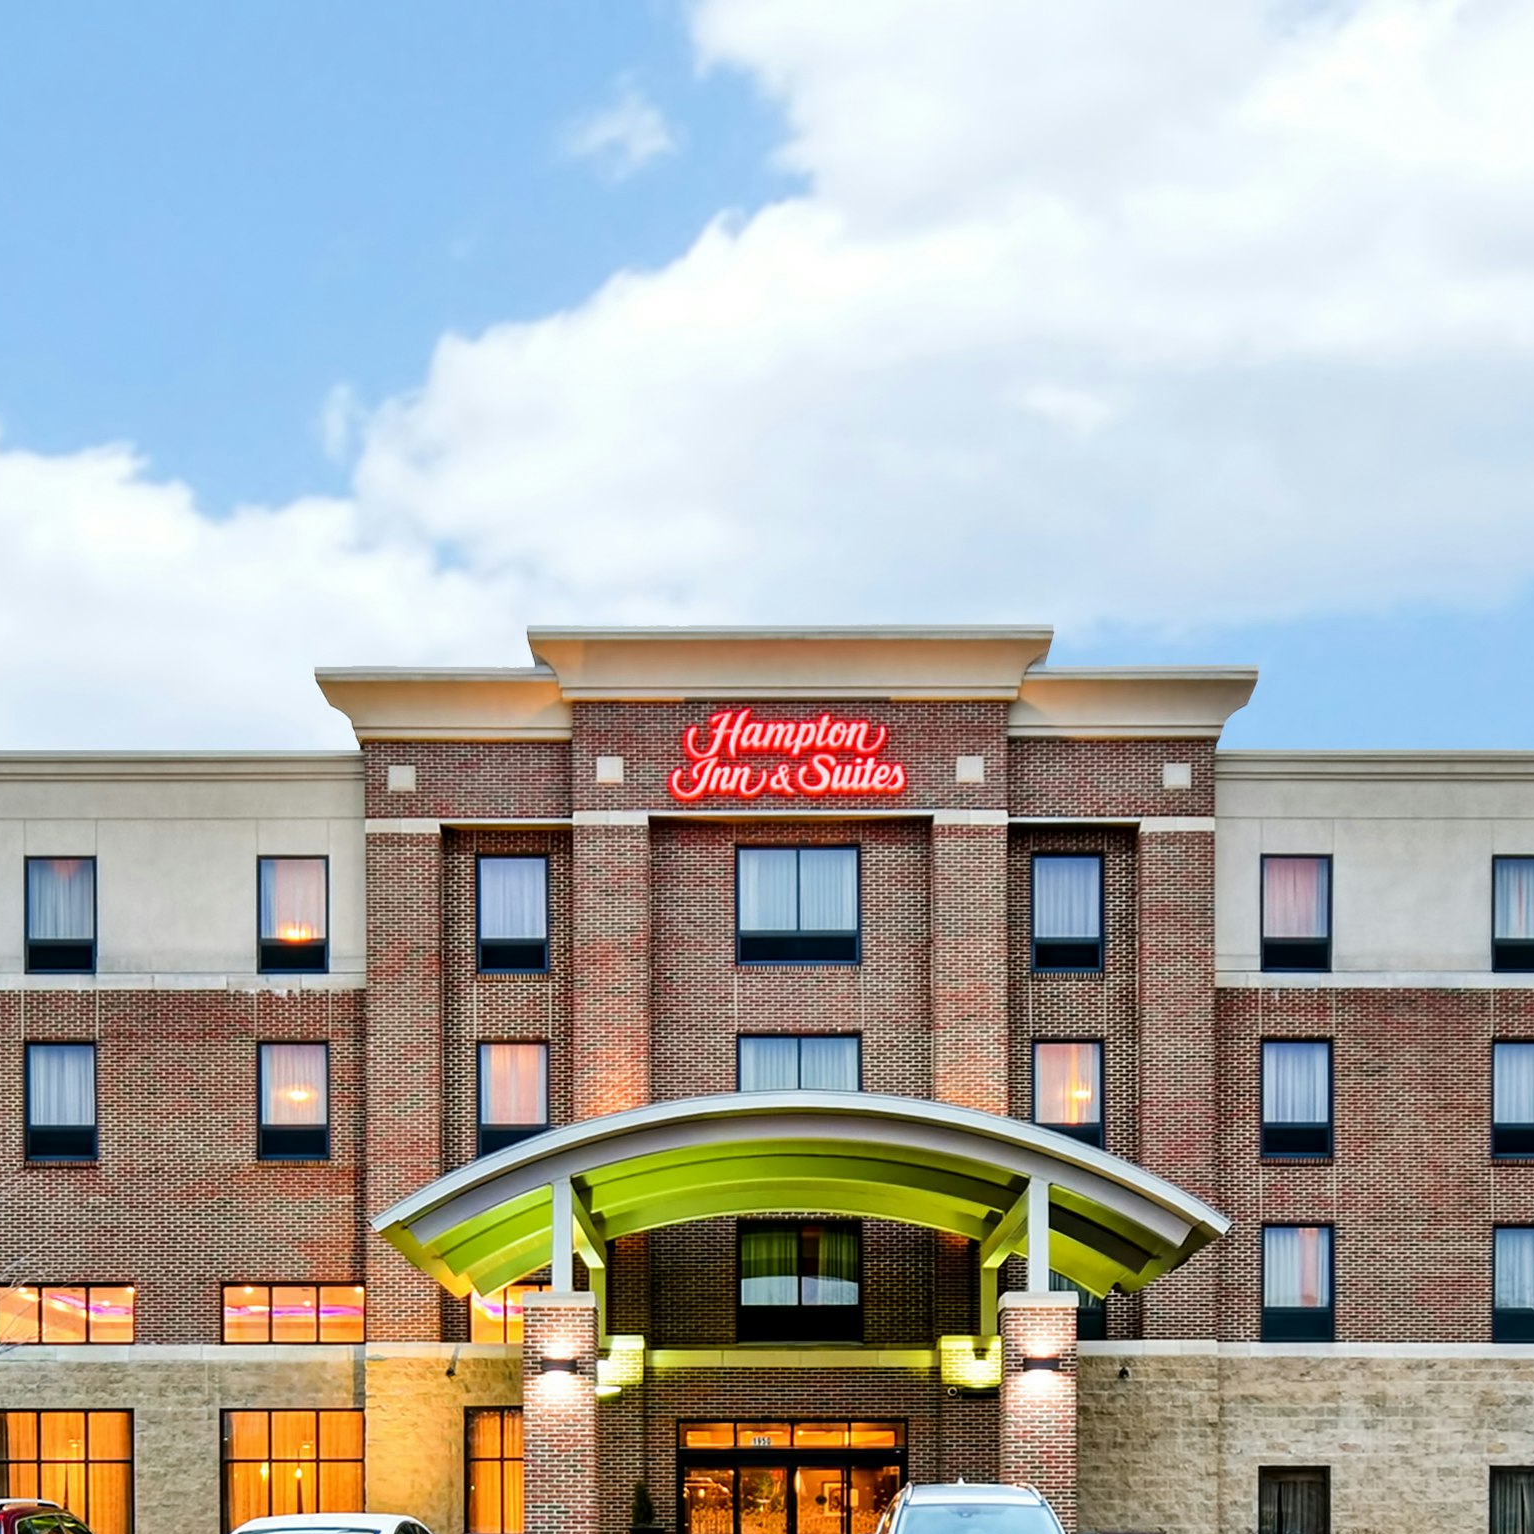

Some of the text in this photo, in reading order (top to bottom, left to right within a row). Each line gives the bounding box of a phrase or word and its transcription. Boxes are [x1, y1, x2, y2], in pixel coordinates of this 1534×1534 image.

[686, 707, 887, 759] Hampton
[671, 753, 906, 797] Inn & Suites
[753, 1436, 772, 1446] 1950
